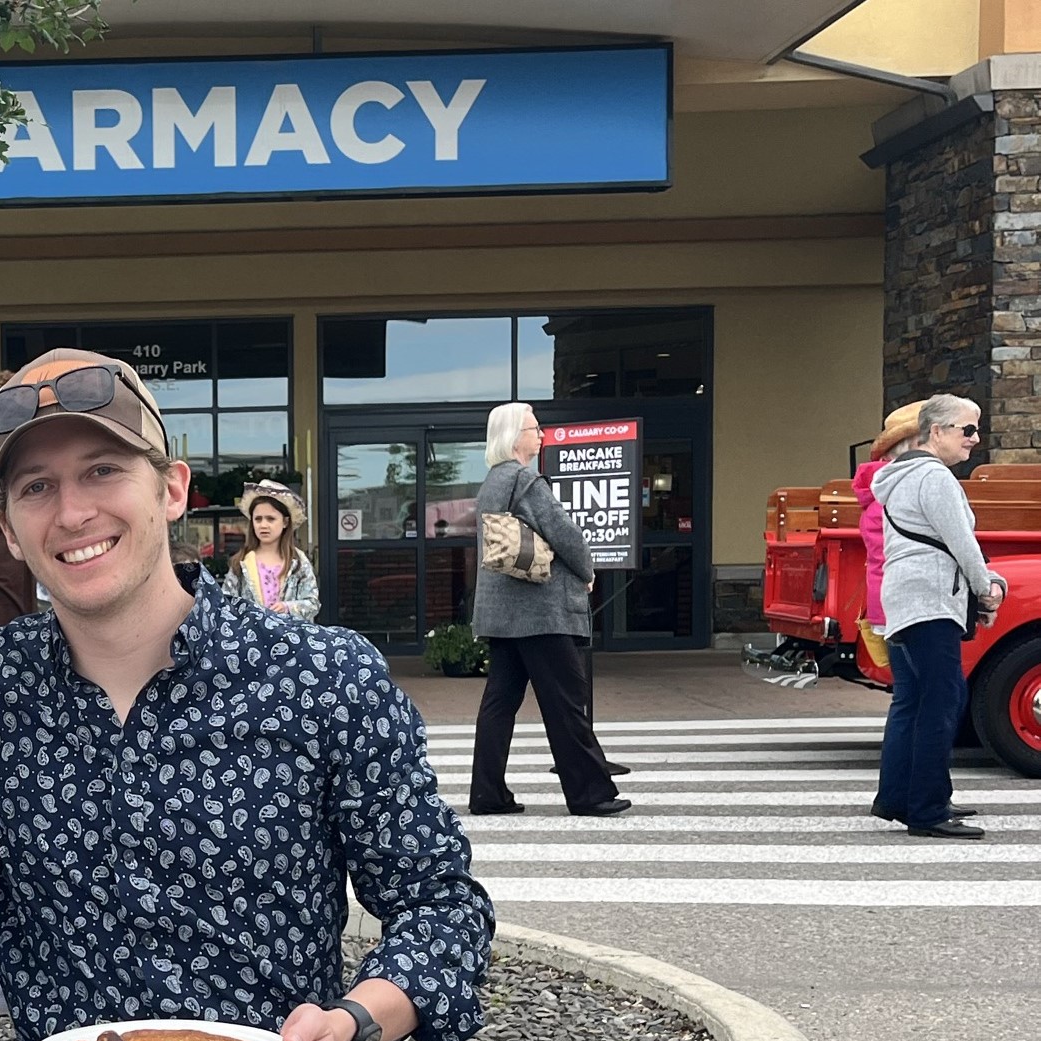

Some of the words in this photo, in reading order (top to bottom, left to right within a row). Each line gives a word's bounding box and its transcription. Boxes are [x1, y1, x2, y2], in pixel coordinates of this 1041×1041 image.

[132, 344, 161, 358] 410
[133, 363, 169, 377] uarry
[172, 360, 207, 374] Park
[568, 426, 604, 438] CALGARY
[559, 446, 623, 462] PANCAKE
[559, 459, 623, 472] BREAKFASTS
[552, 478, 630, 510] LINE
